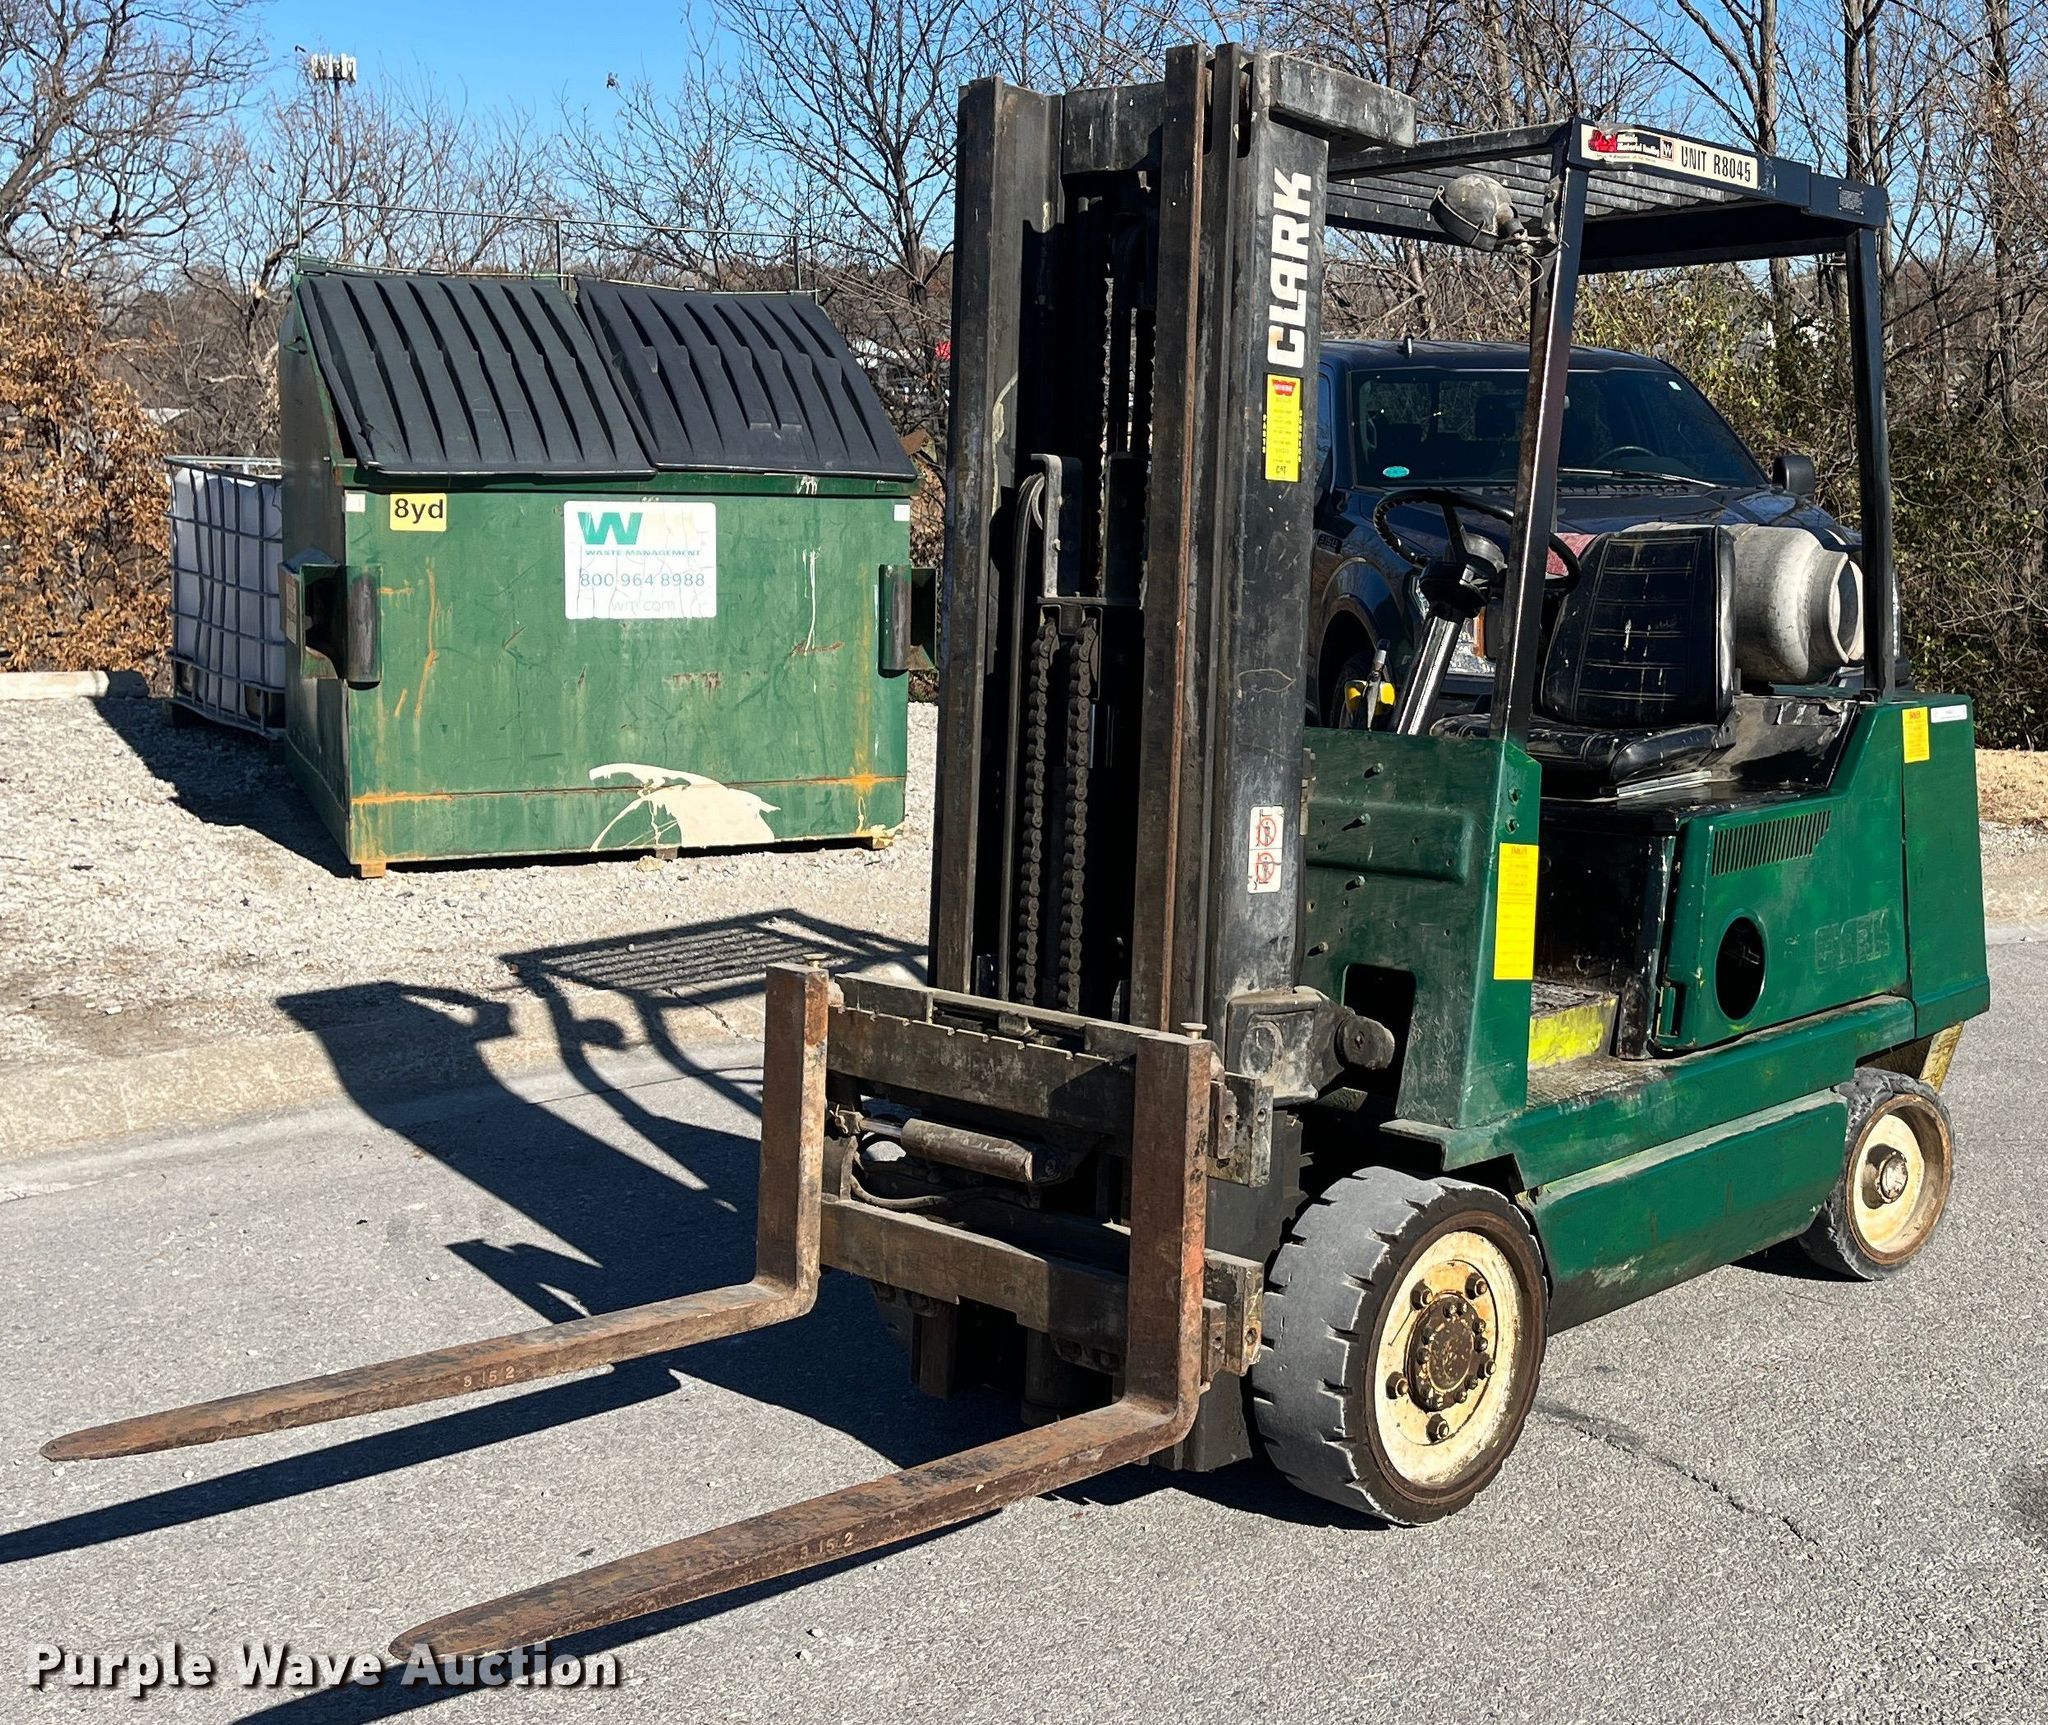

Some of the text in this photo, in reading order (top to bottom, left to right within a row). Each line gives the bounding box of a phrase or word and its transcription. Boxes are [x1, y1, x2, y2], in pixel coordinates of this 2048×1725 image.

[1681, 146, 1751, 183] UNIT R8045
[1267, 167, 1312, 369] CLARK
[394, 498, 444, 525] 8yd
[585, 549, 702, 557] WASTE MANAGEMENT
[580, 573, 706, 588] 800 964 8988
